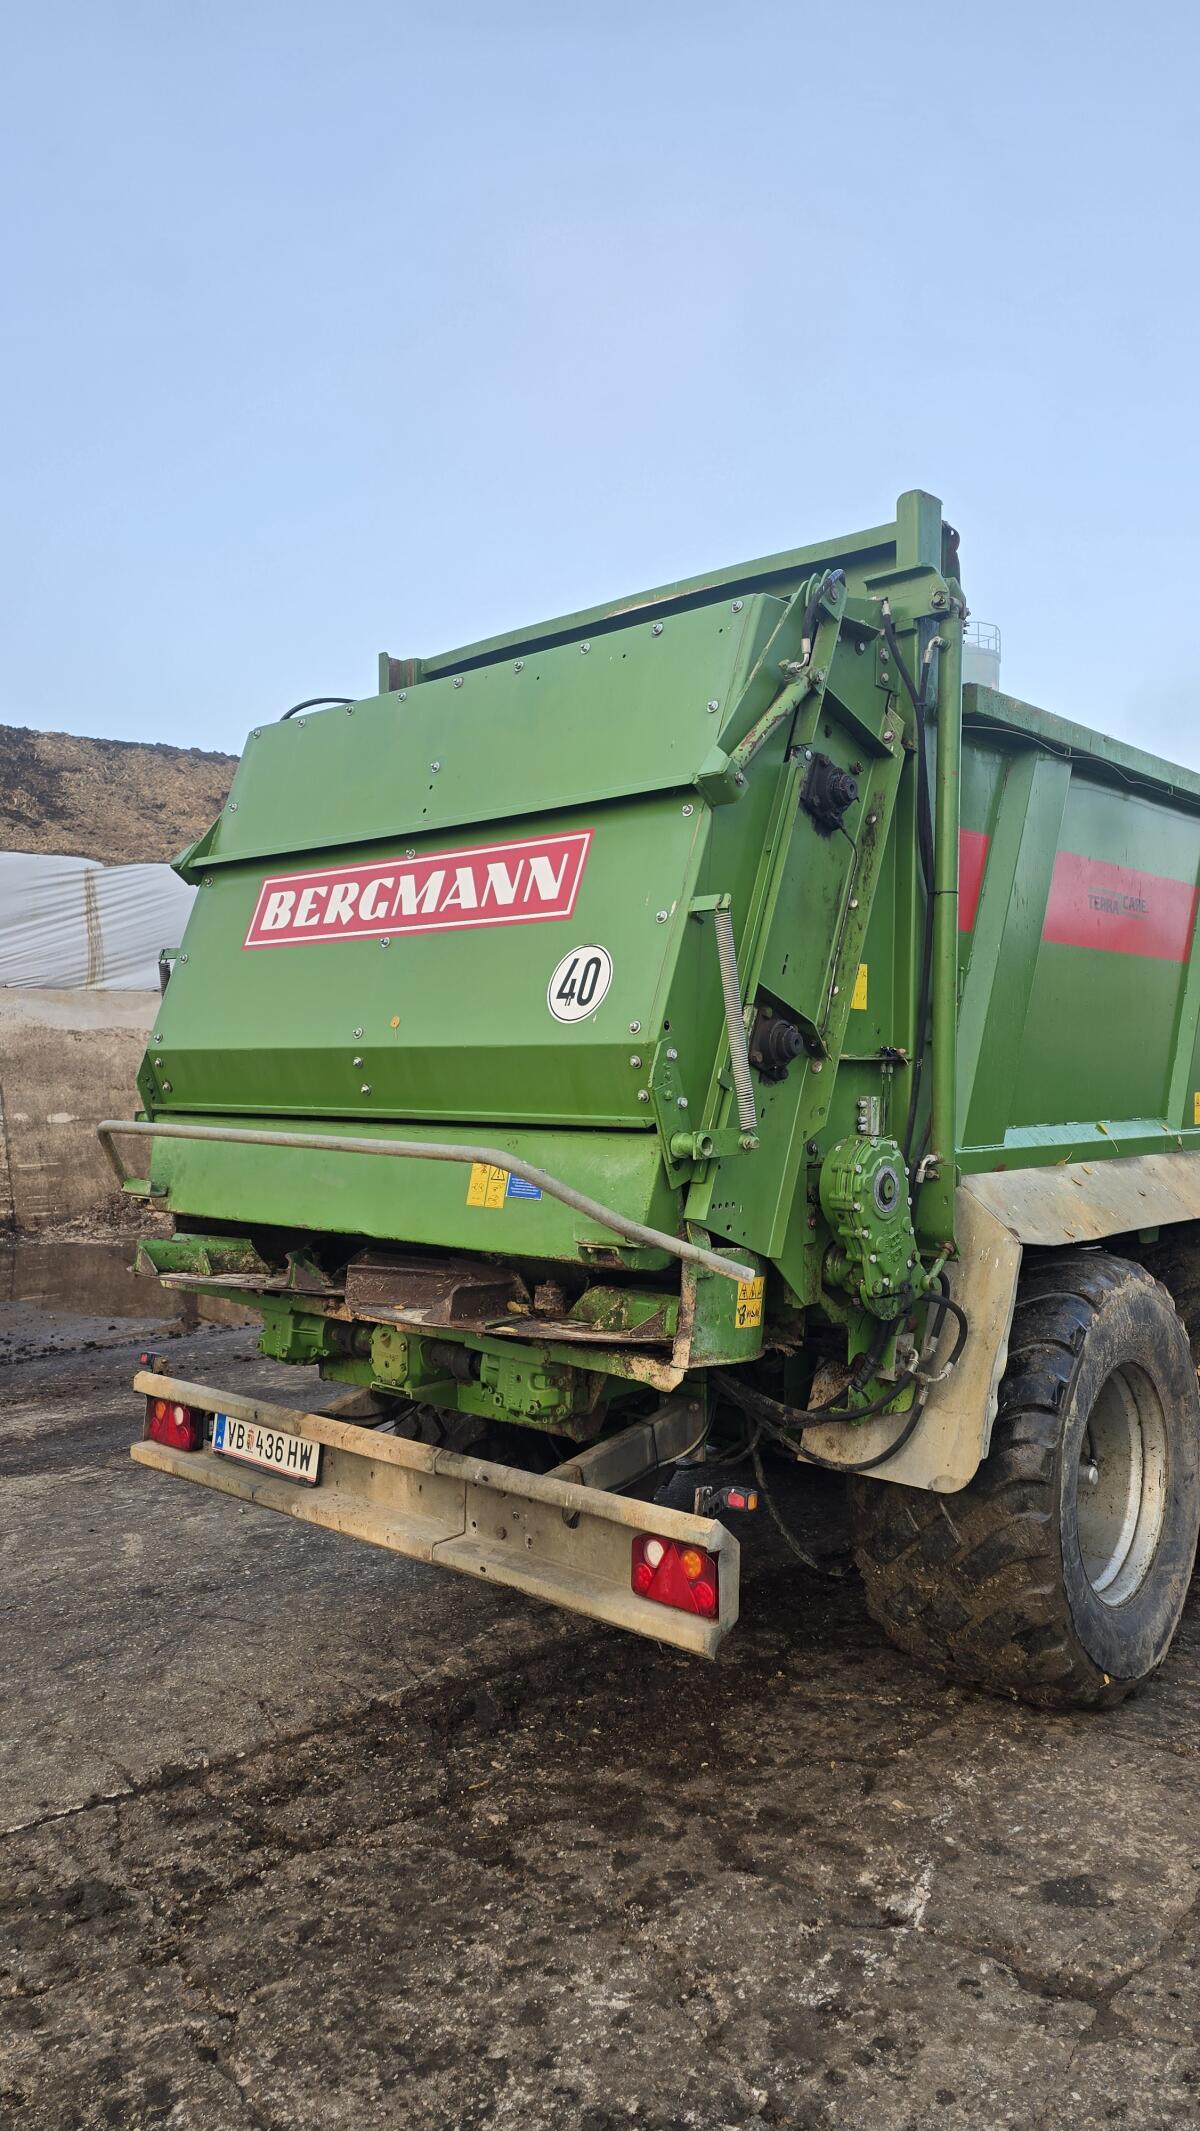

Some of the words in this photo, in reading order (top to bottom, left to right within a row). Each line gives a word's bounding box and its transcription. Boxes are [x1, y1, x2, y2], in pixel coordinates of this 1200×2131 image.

[260, 853, 569, 931] BERGMANN
[556, 957, 602, 1007] 40
[228, 1421, 245, 1449] VB
